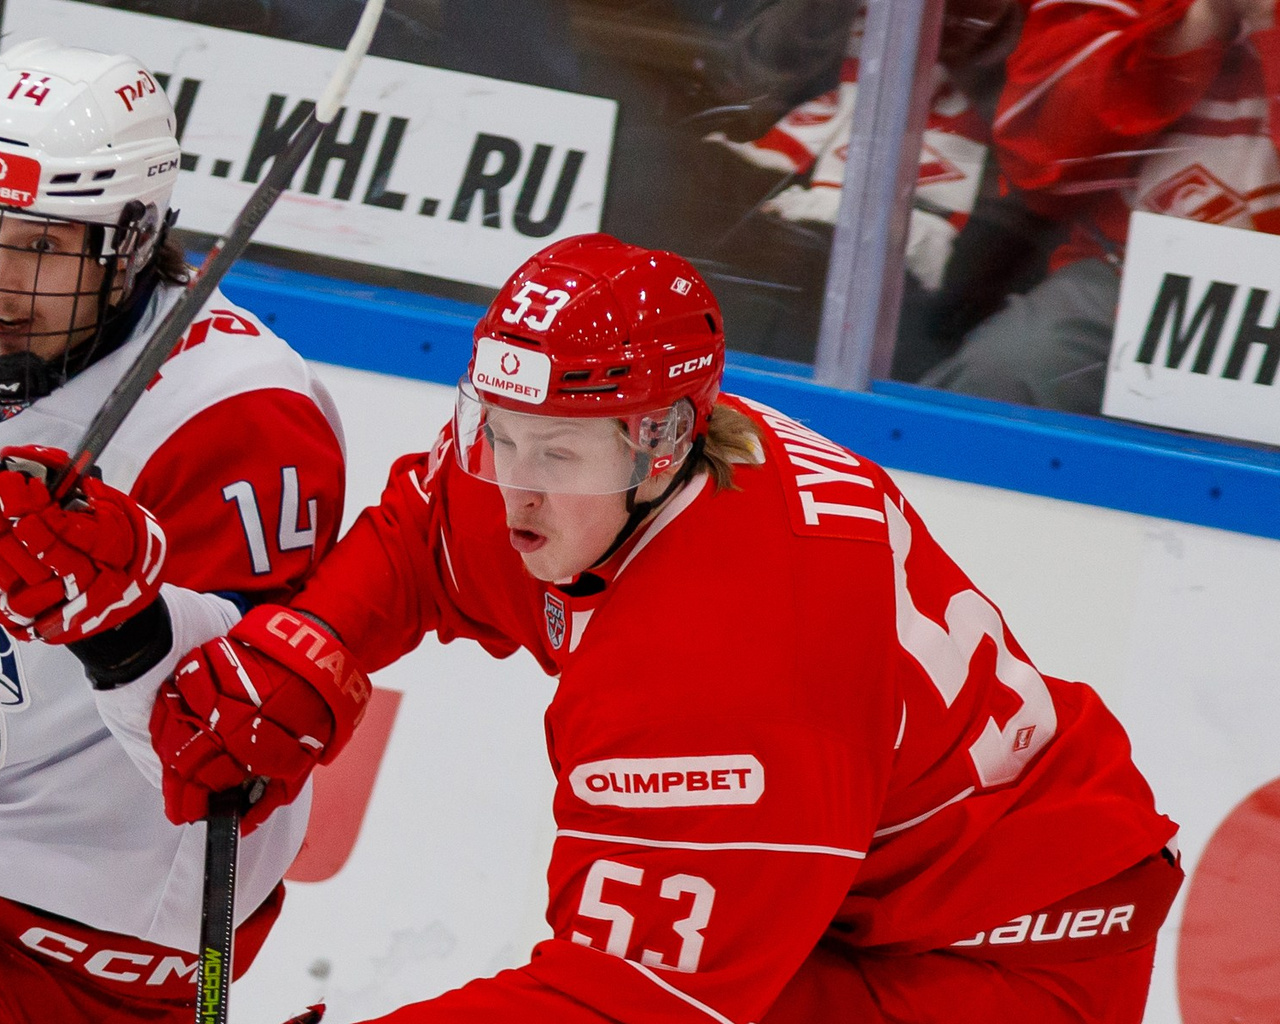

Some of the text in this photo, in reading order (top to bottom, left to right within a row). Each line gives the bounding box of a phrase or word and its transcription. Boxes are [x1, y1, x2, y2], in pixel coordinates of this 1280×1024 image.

[7, 72, 51, 106] 14
[147, 158, 179, 178] CCM
[153, 72, 587, 239] L.KHL.RU
[501, 281, 571, 332] 53
[476, 372, 542, 399] OLIMPBET
[668, 353, 714, 378] CCM
[221, 465, 318, 576] 14
[265, 611, 372, 727] СПАР
[585, 768, 752, 794] OLIMPBET
[570, 858, 717, 974] 53
[19, 926, 202, 986] CCM
